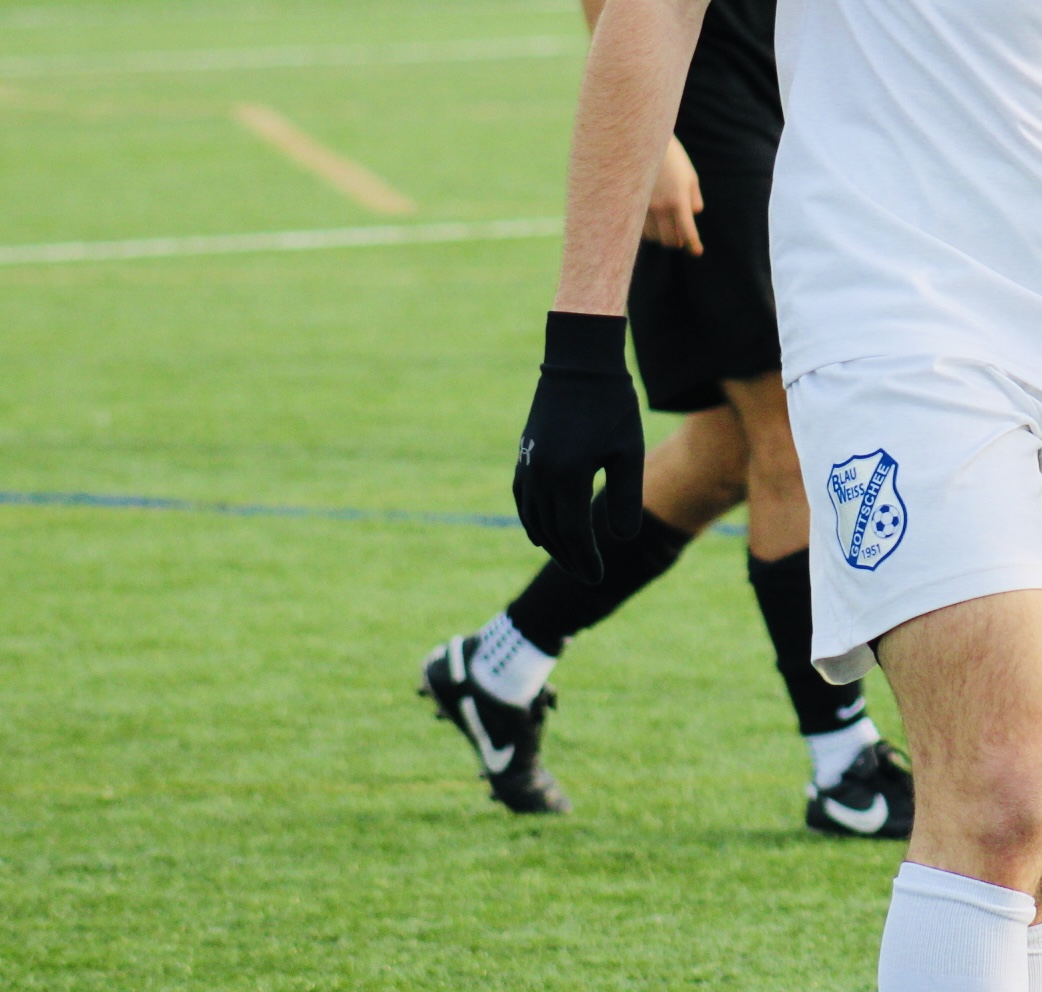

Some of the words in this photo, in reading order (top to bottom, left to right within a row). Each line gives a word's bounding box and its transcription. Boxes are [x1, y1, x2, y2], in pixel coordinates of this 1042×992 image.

[831, 467, 857, 493] BLAU
[836, 483, 866, 504] WEISS
[850, 462, 890, 557] GOTTSCHEE
[861, 543, 881, 560] 1951
